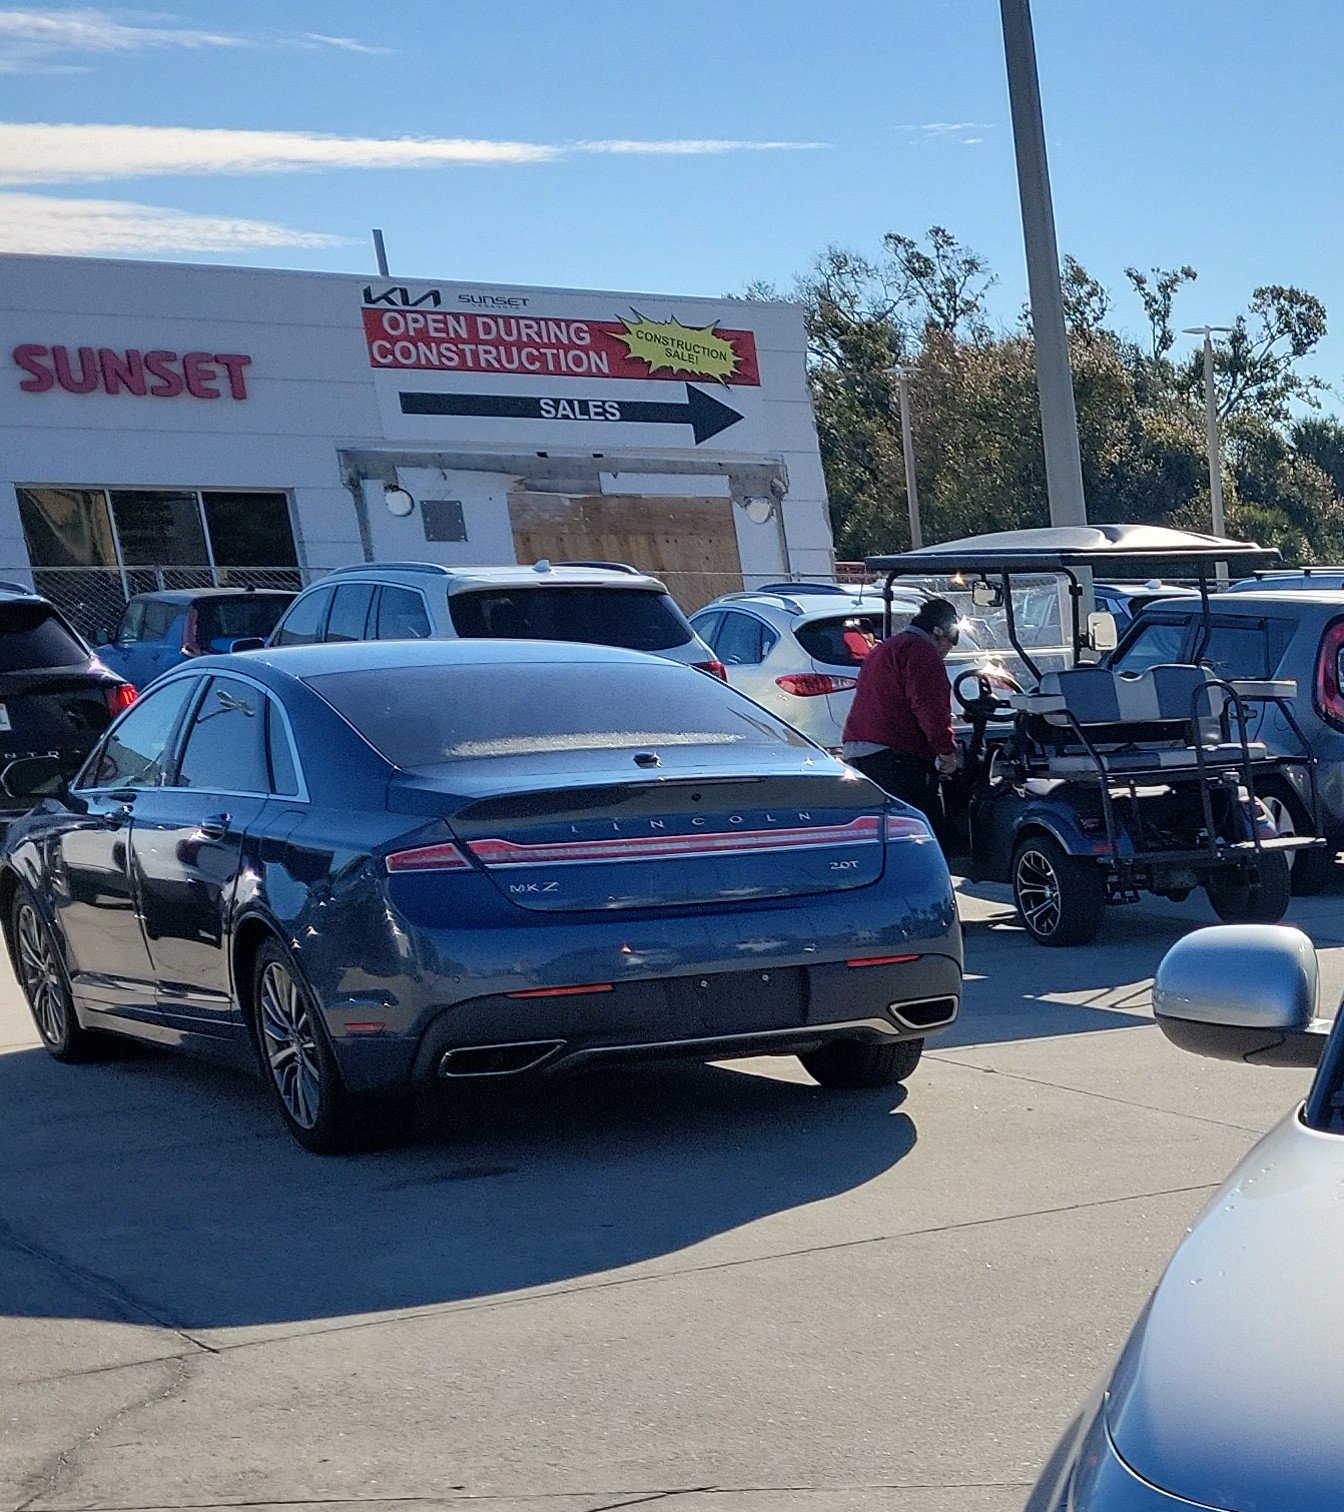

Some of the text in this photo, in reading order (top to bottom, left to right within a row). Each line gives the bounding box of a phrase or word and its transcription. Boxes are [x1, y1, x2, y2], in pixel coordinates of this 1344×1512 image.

[458, 293, 530, 307] SUNSET
[382, 311, 591, 346] OPEN DURING
[371, 339, 611, 374] CONSTRUCTION
[636, 329, 727, 362] CONSTRUCTION
[665, 347, 699, 365] SALE!
[12, 343, 252, 401] SUNSET
[540, 399, 621, 420] SALES
[571, 812, 812, 834] LINCOLN
